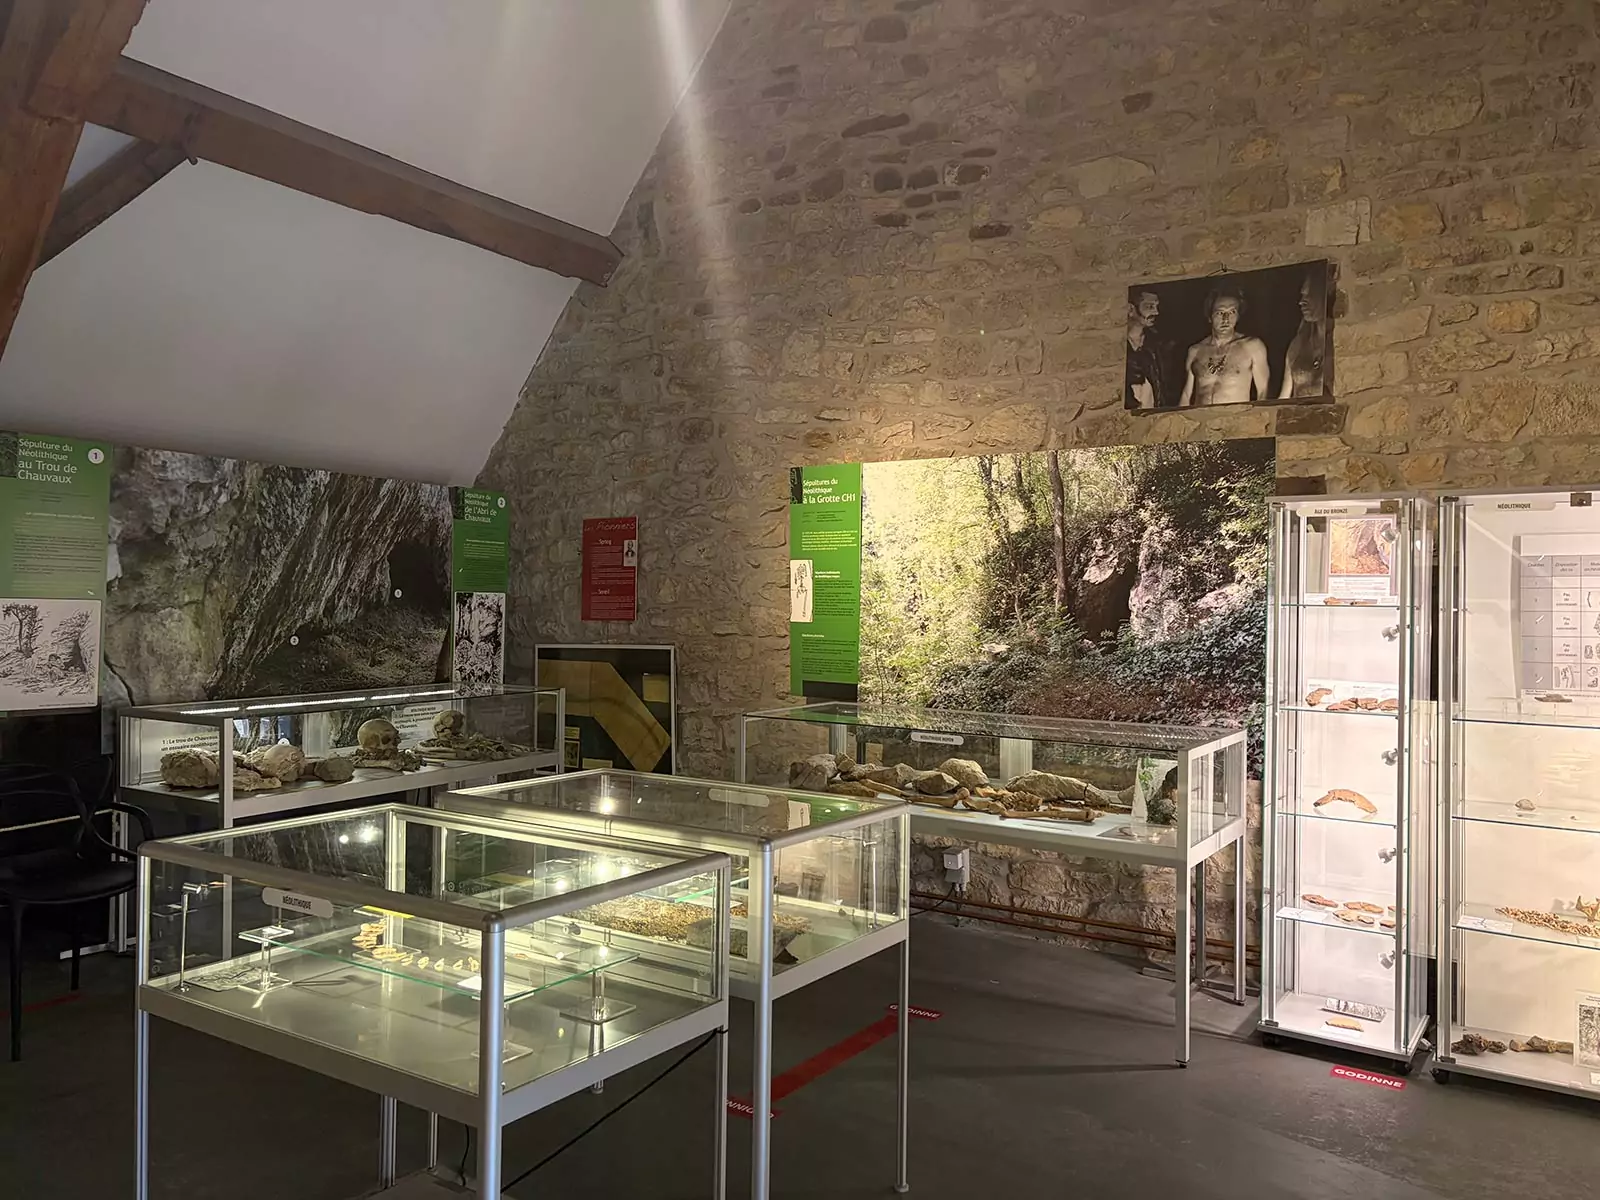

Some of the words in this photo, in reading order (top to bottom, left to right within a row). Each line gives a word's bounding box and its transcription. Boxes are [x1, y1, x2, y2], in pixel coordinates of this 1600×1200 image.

[19, 438, 61, 451] Sépulture
[62, 444, 73, 452] du
[19, 449, 68, 462] Néolithique
[92, 452, 98, 460] 1
[18, 460, 32, 469] au
[36, 460, 60, 472] Trou
[63, 464, 78, 474] de
[18, 469, 72, 484] Chauvaux
[802, 479, 830, 488] Sépultures
[830, 478, 839, 486] du
[809, 496, 816, 504] la
[817, 495, 841, 504] Grotte
[464, 505, 472, 513] de
[890, 1004, 940, 1018] GDINNE
[1333, 1068, 1403, 1088] GODINNE
